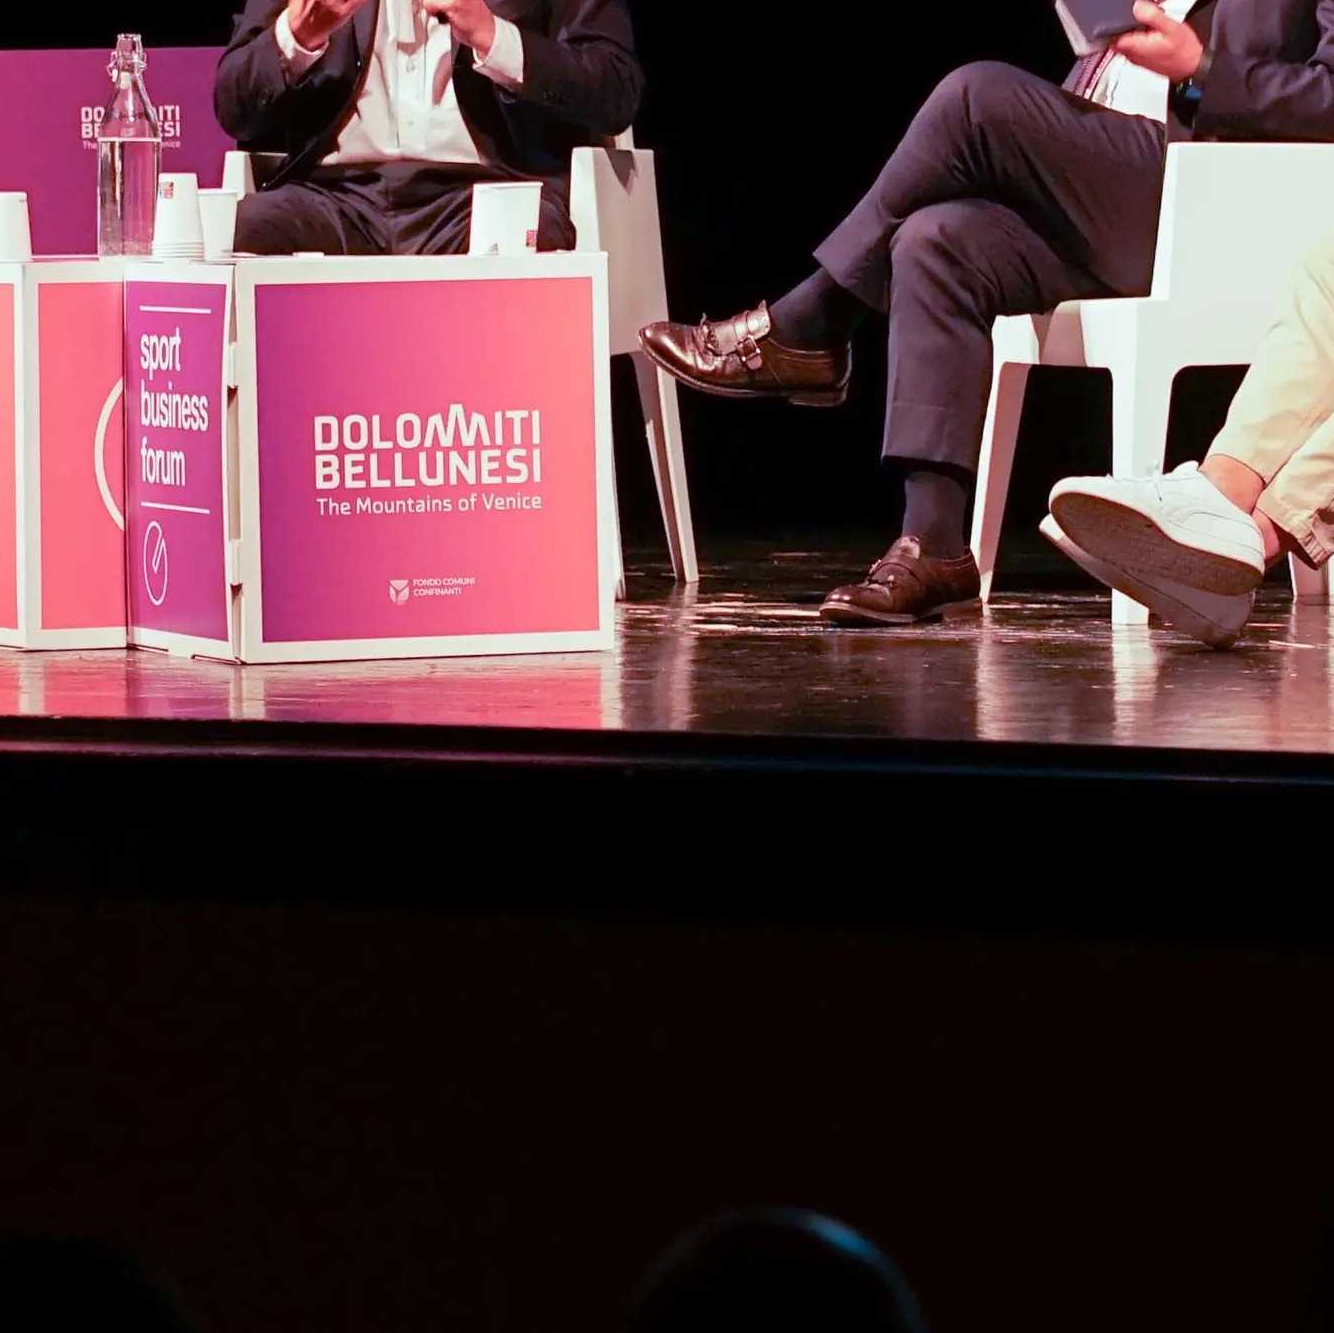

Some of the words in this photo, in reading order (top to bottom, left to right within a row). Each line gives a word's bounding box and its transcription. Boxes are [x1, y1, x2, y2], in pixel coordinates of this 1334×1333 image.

[140, 327, 182, 380] sport
[140, 380, 209, 431] business
[314, 402, 541, 451] DOLOMITI
[140, 436, 186, 487] forum
[315, 448, 542, 490] BELLUNESI
[316, 497, 352, 516] The
[356, 494, 452, 515] Mountains
[458, 493, 478, 512] of
[483, 492, 542, 511] Venice
